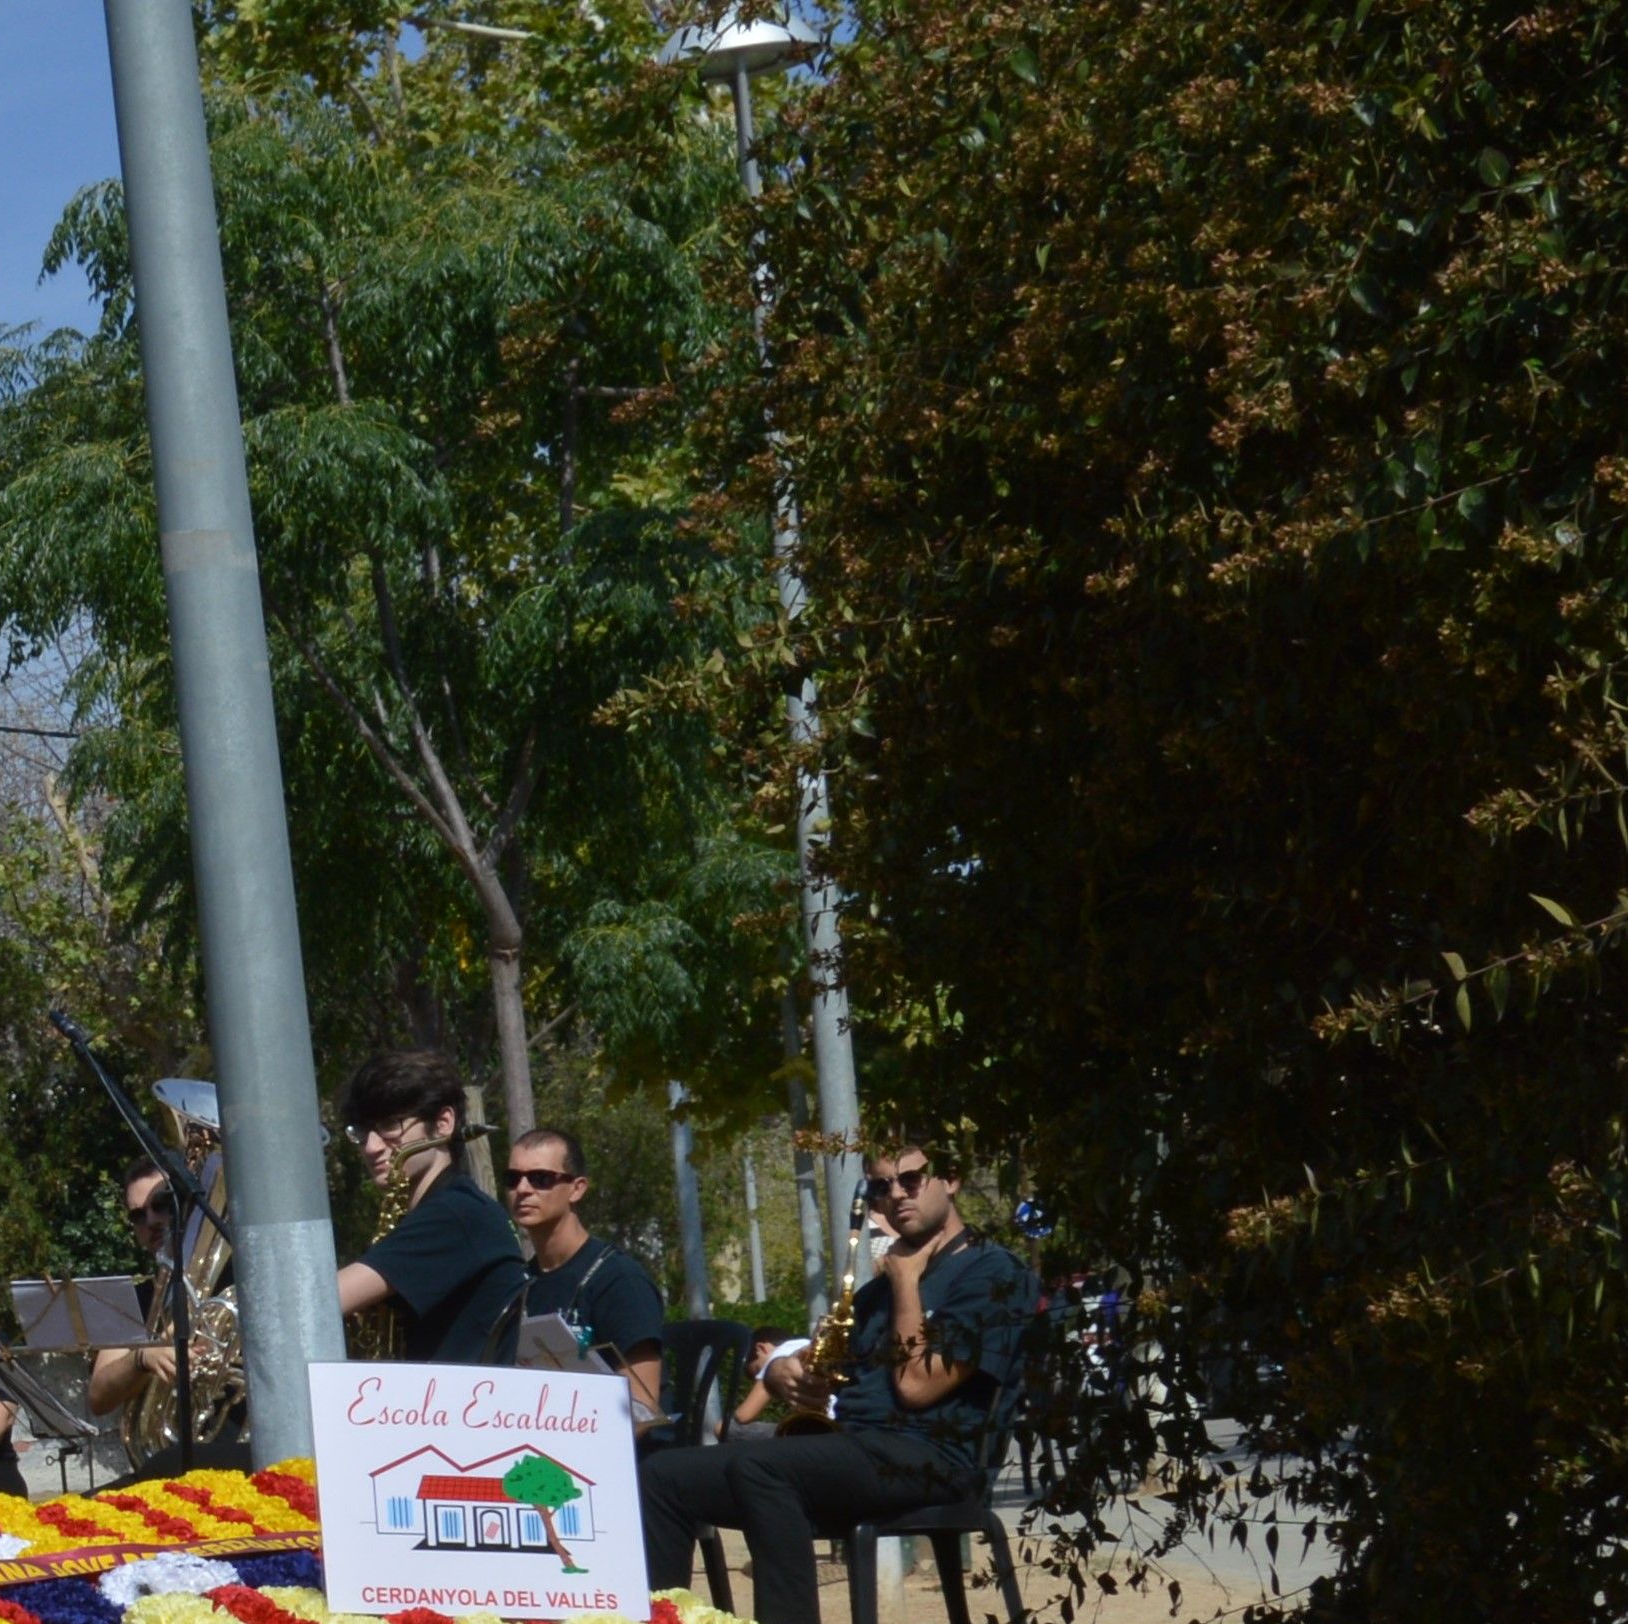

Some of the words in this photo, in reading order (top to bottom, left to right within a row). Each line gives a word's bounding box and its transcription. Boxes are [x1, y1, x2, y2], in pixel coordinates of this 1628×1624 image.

[347, 1376, 449, 1427] Escola
[461, 1380, 600, 1435] Escaladei
[361, 1586, 498, 1607] CERDANYOLA
[504, 1590, 541, 1608] DEL
[546, 1588, 618, 1610] VALLÈS
